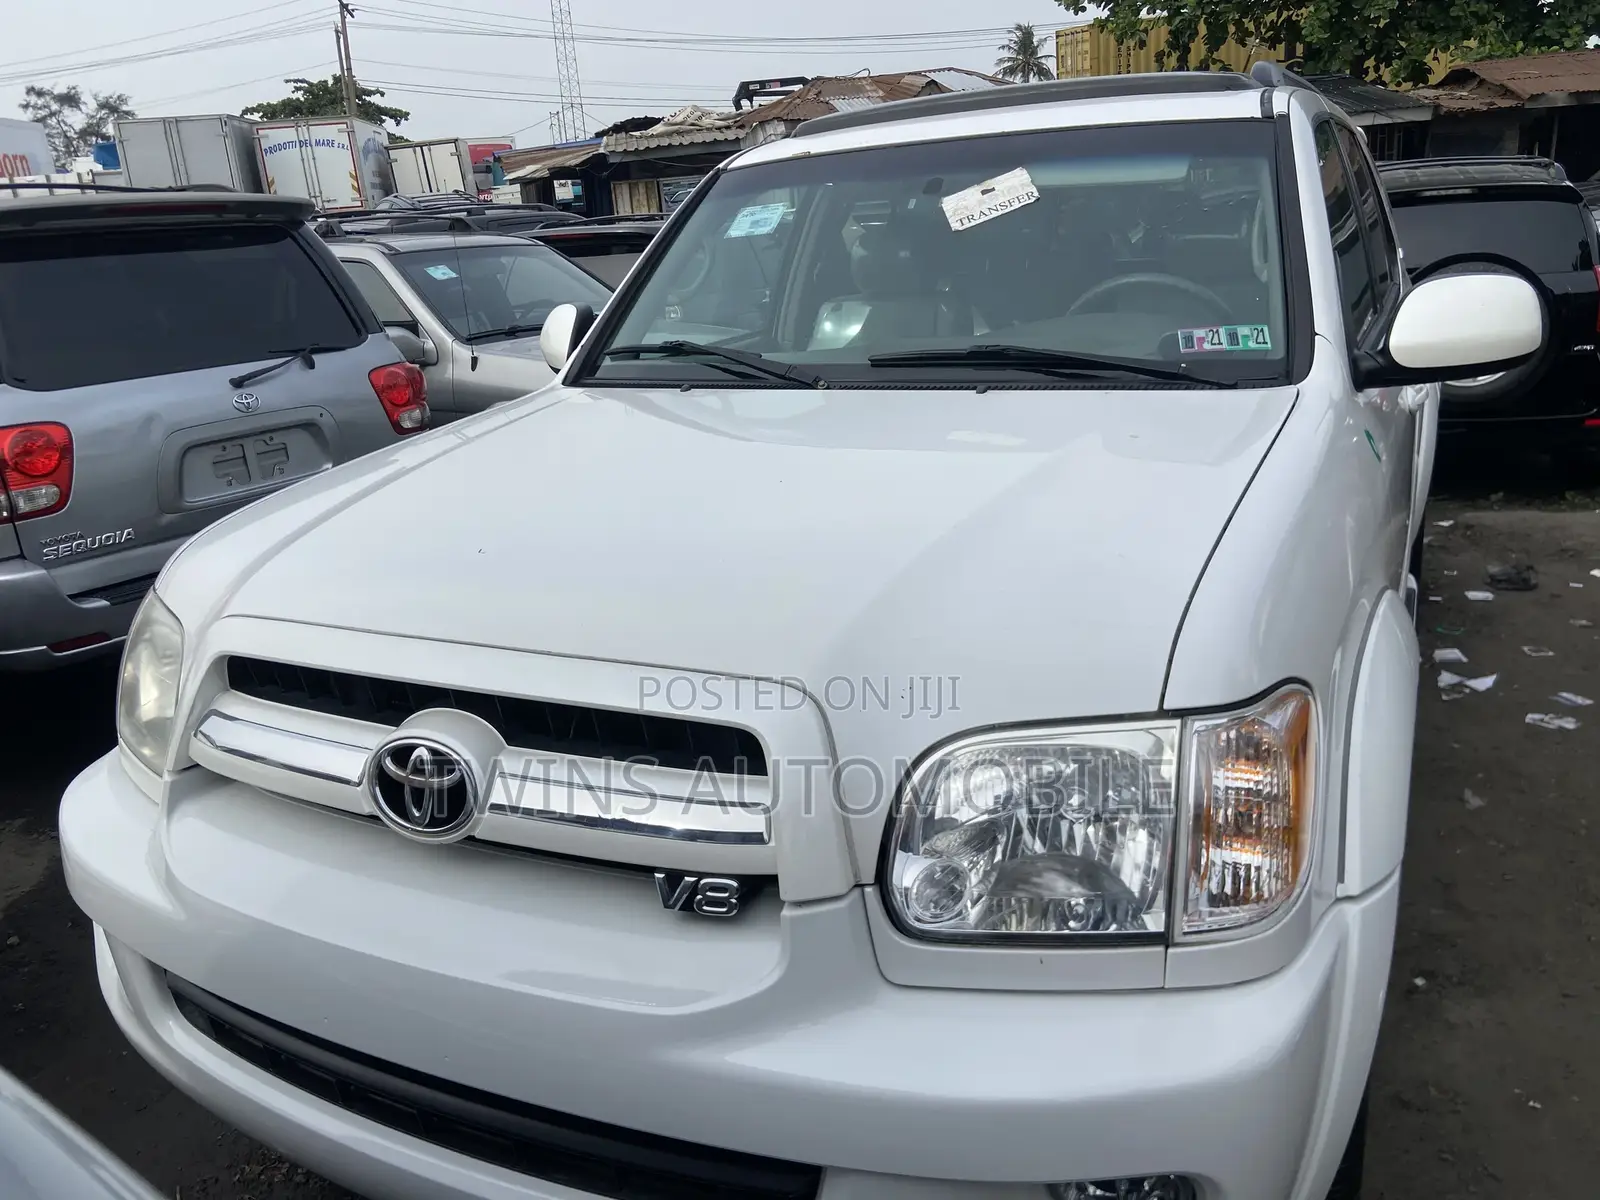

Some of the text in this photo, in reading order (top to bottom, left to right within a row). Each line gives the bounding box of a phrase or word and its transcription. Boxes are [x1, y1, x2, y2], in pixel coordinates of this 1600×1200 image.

[263, 140, 297, 157] PRODOTTI
[299, 139, 313, 149] DEL
[314, 138, 336, 148] MARE
[0, 153, 31, 178] orn
[956, 191, 1036, 226] TRANSFER
[1208, 328, 1223, 346] 21
[1253, 327, 1268, 345] 21
[40, 530, 84, 545] TOYOTA
[43, 528, 135, 560] SEQUOIA
[654, 872, 740, 916] V8
